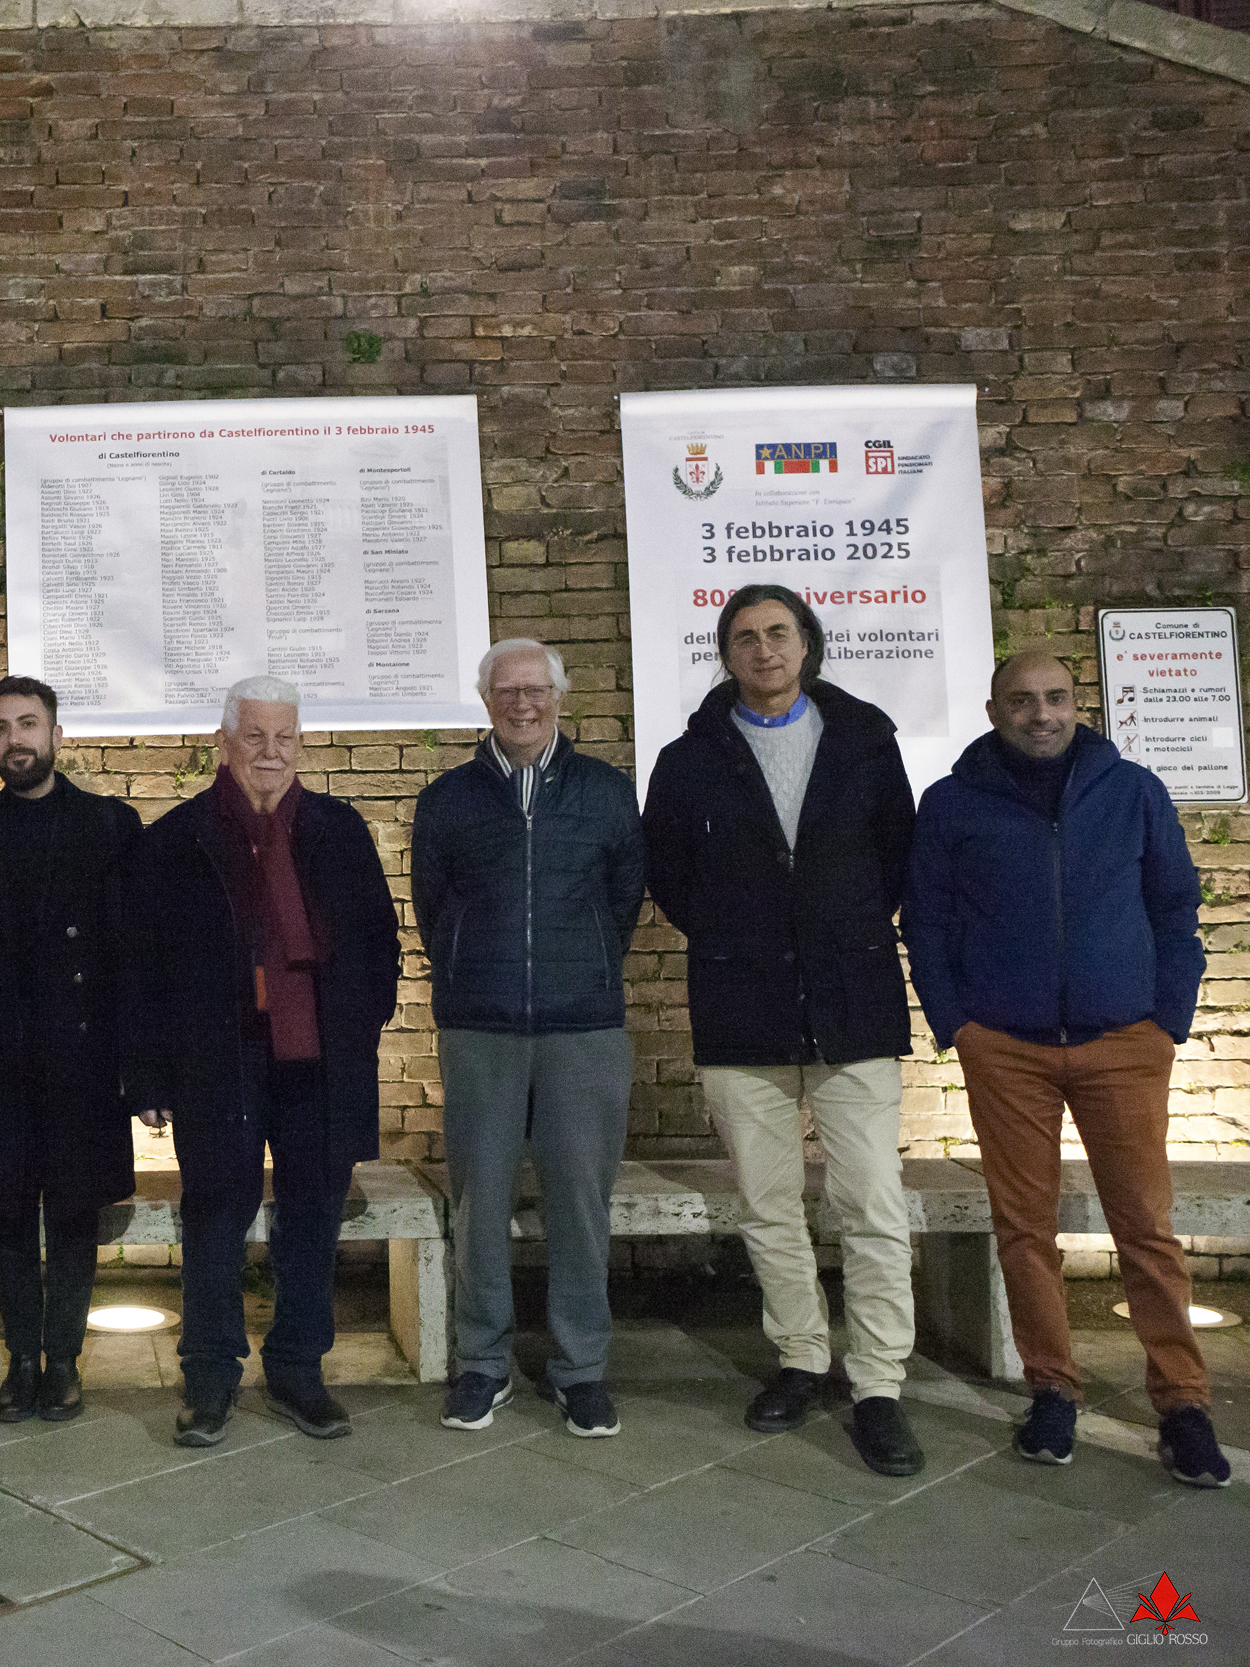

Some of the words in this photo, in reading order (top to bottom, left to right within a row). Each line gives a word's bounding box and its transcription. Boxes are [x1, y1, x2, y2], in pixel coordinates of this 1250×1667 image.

[49, 432, 107, 443] Volontari
[110, 431, 133, 441] che
[137, 430, 196, 442] partirono
[199, 429, 215, 438] da
[218, 427, 319, 438] Castelfiorentino
[324, 426, 331, 436] il
[335, 426, 343, 436] 3
[347, 425, 399, 435] febbraio
[404, 424, 435, 434] 1945
[864, 440, 893, 449] CGIL
[98, 452, 107, 460] di
[109, 451, 180, 459] Castelfiorentino
[774, 443, 836, 460] A.N.P.I.
[868, 457, 892, 473] SPI
[701, 522, 716, 540] 3
[725, 520, 834, 539] febbraio
[845, 518, 910, 537] 1945
[702, 546, 717, 564] 3
[726, 544, 836, 563] febbraio
[846, 542, 911, 560] 2025
[824, 629, 851, 642] dei
[857, 628, 939, 642] volontari
[1129, 630, 1228, 640] CASTELFIORENTINO
[826, 646, 934, 660] Liberazione
[1132, 650, 1223, 661] severamente
[1148, 667, 1197, 677] vietato
[1165, 695, 1191, 703] 23.00
[1211, 694, 1231, 702] 7.00
[1156, 764, 1178, 773] gioco
[1198, 764, 1228, 772] pallone
